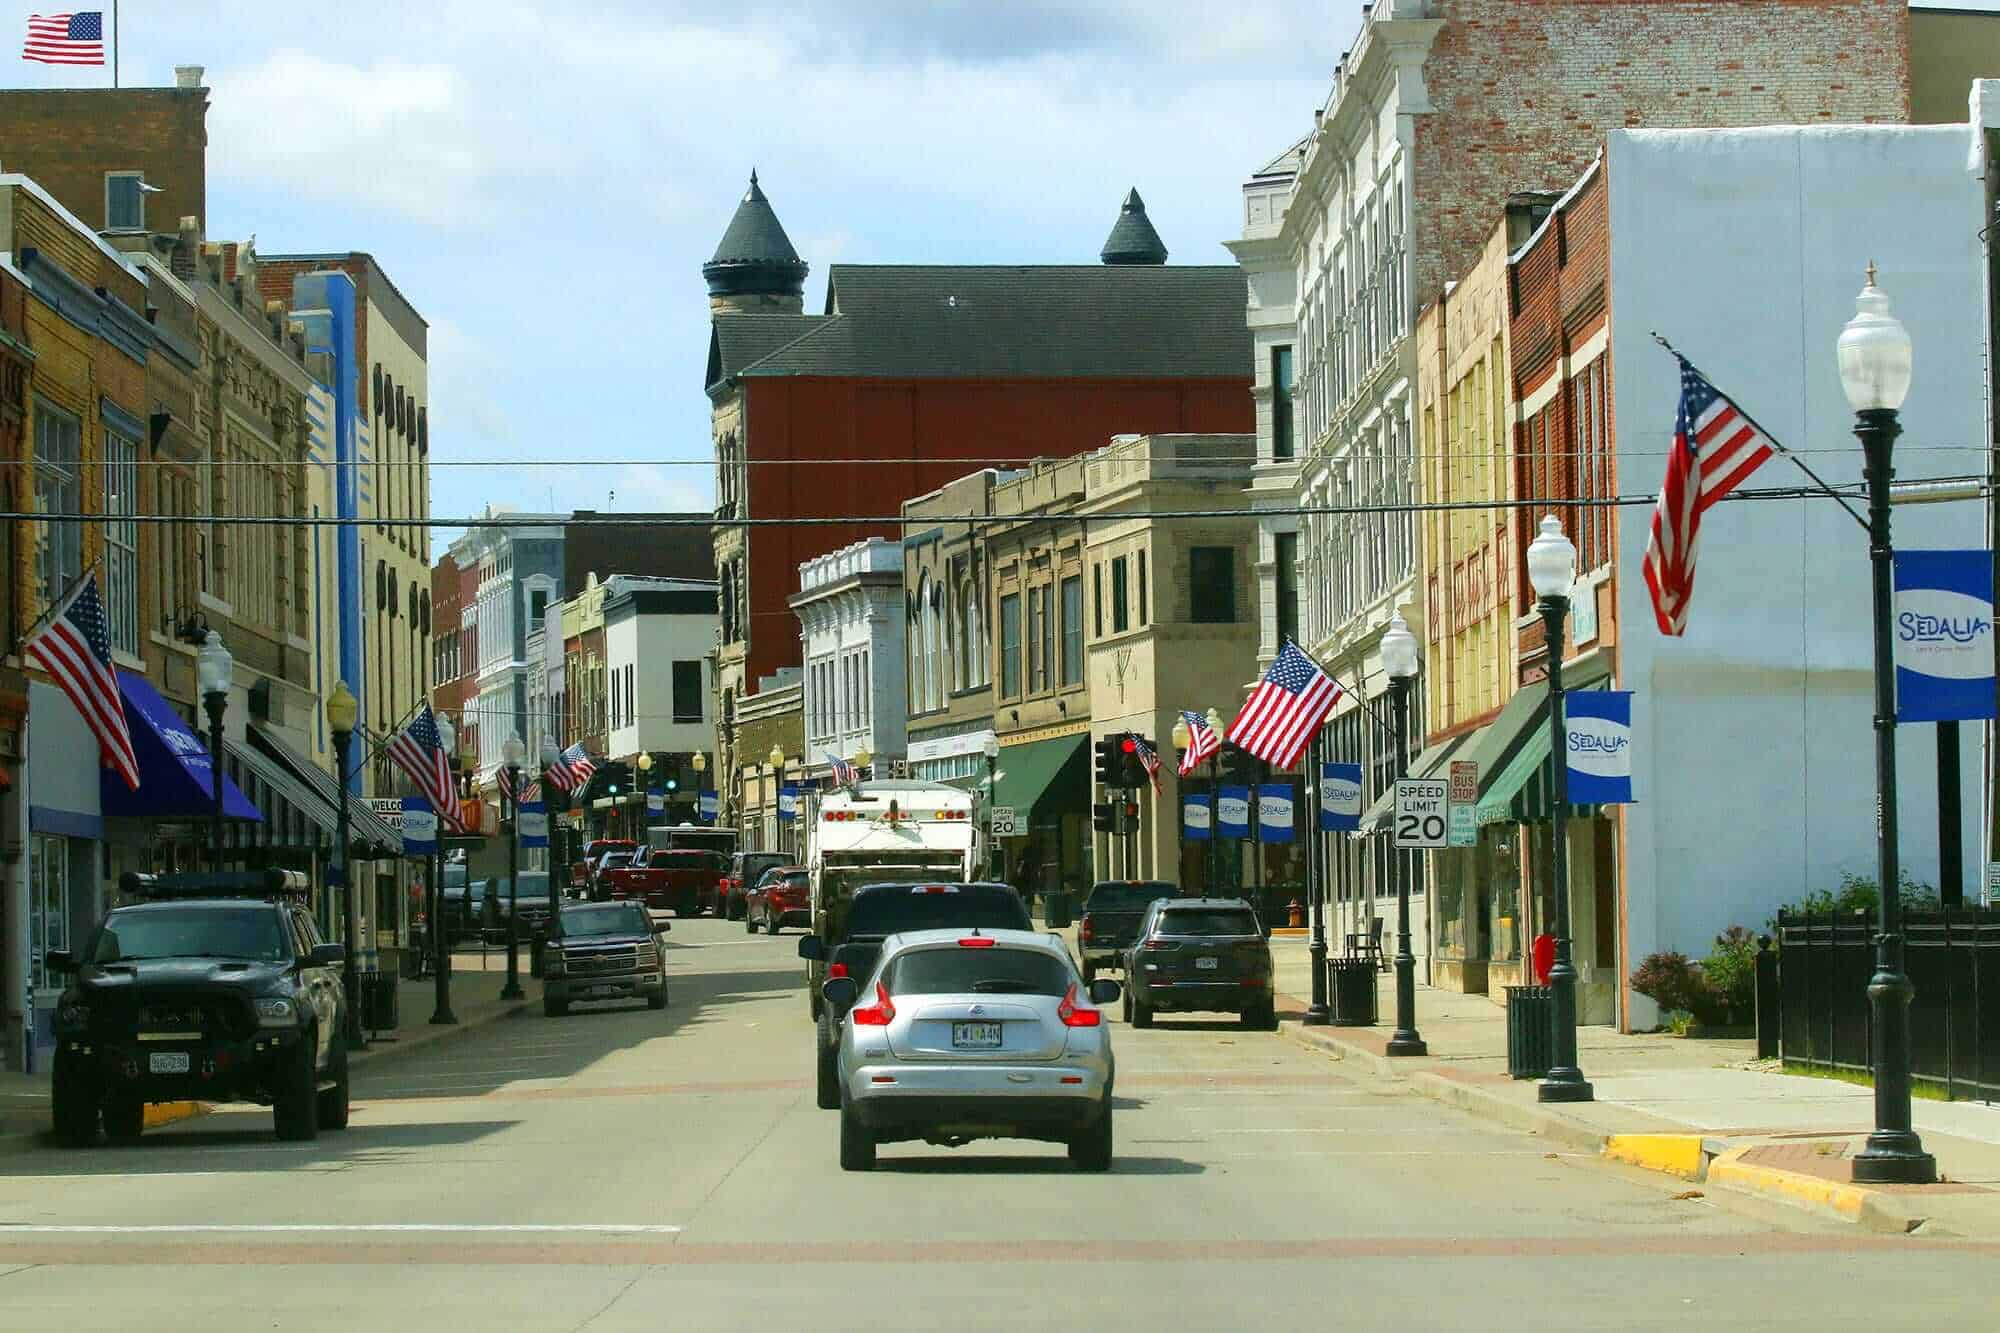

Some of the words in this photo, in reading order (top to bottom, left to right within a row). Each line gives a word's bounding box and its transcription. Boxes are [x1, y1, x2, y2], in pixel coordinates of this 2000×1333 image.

[1899, 612, 1991, 642] SEDALIA
[1569, 731, 1628, 753] SEDALIA
[1454, 776, 1473, 787] BUS
[1399, 786, 1444, 798] SPEED
[1453, 788, 1474, 799] STOP
[1404, 801, 1438, 812] LIMIT
[993, 822, 1013, 833] 20
[1398, 815, 1445, 840] 20
